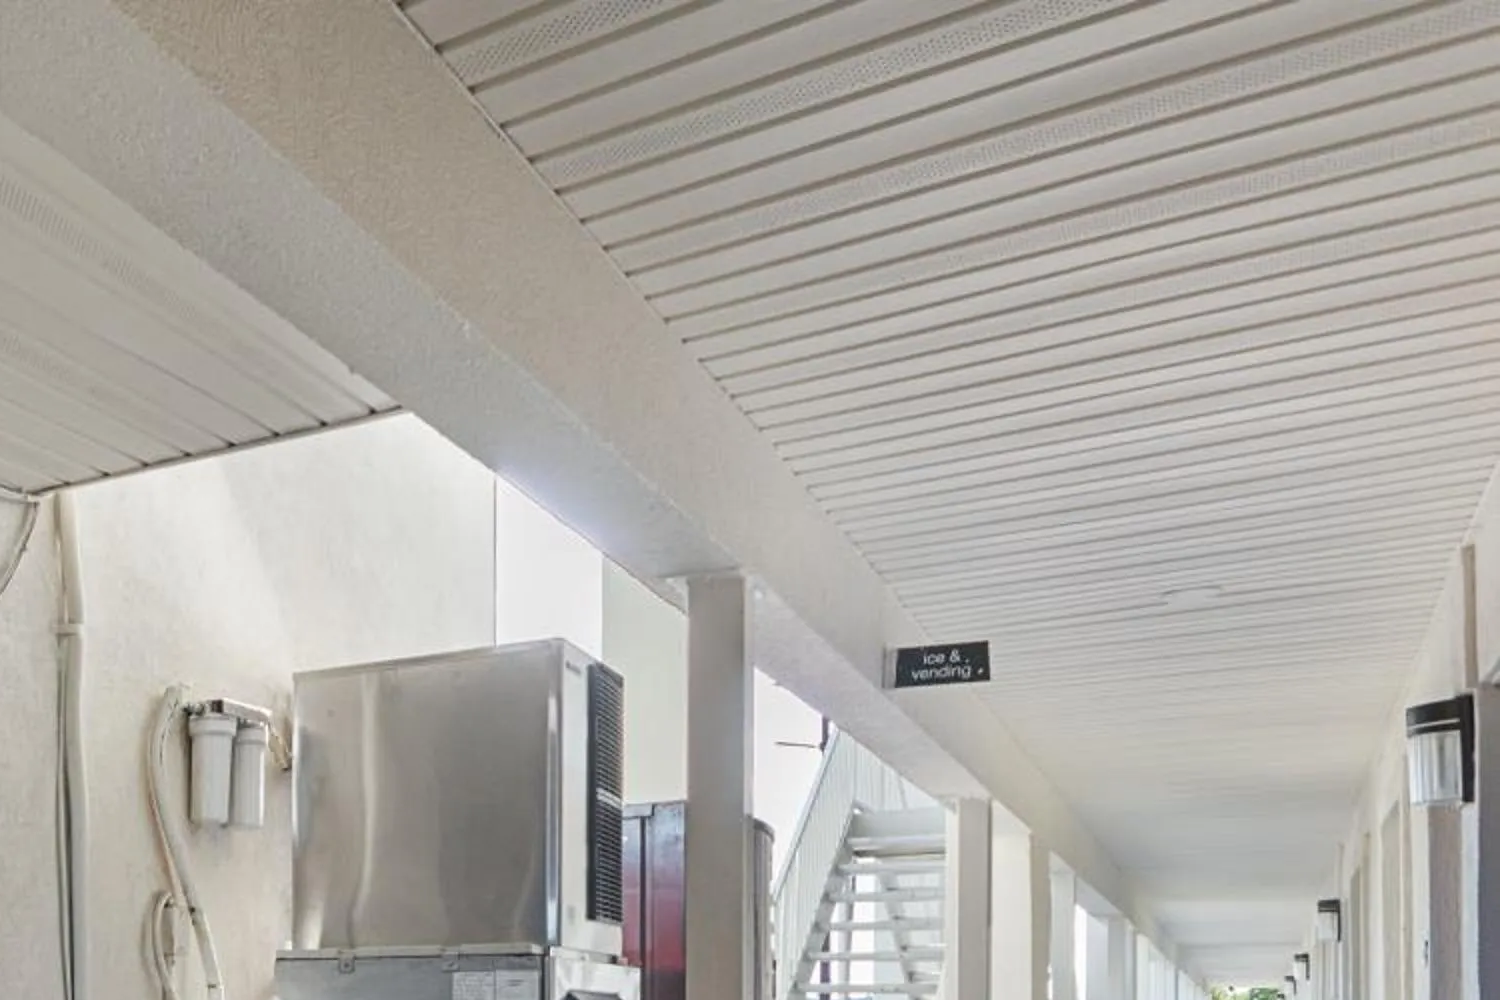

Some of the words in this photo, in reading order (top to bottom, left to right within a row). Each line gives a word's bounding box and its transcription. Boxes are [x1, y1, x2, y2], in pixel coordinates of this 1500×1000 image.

[923, 652, 946, 665] ice
[949, 649, 961, 663] &
[911, 664, 972, 681] vending
